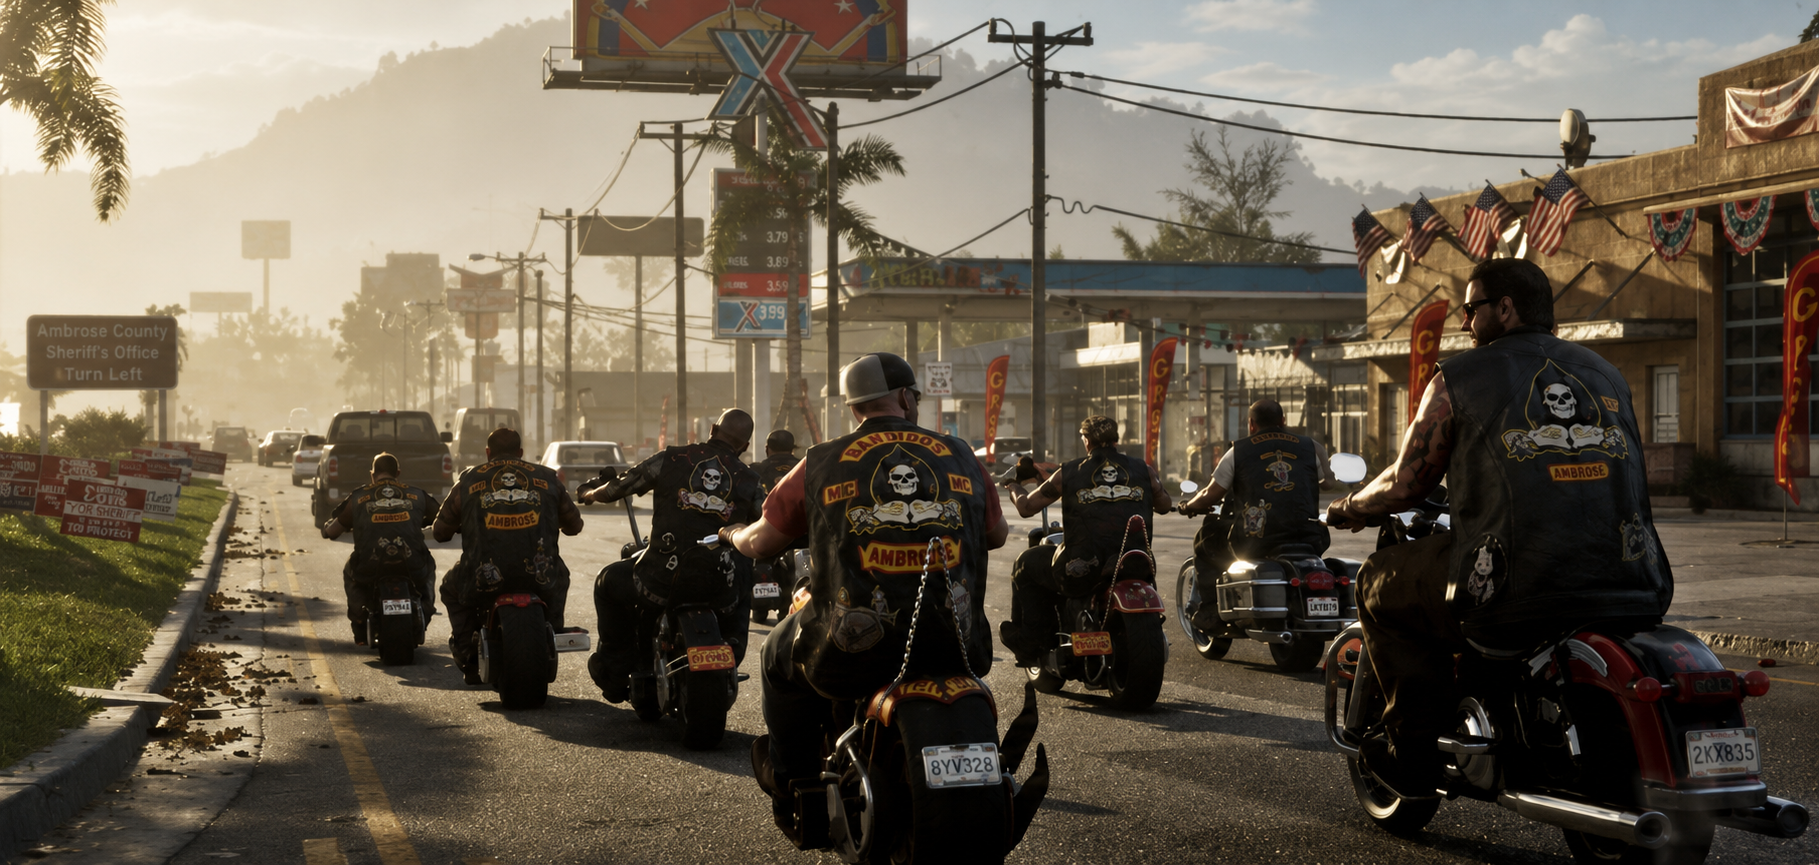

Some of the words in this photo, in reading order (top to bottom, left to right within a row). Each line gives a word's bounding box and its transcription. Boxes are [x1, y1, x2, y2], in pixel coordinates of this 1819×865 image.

[766, 231, 788, 243] 3.79
[766, 256, 789, 267] 3.89
[766, 280, 789, 292] 3.59
[37, 323, 108, 338] Ambrose
[113, 323, 168, 341] County
[46, 345, 109, 359] Sheriff's
[114, 345, 159, 359] Office
[64, 367, 103, 381] Turn
[109, 367, 143, 381] Left
[844, 432, 946, 459] BANDIDOS
[1554, 464, 1606, 479] AMBROSE
[951, 476, 971, 492] MC
[487, 513, 537, 528] AMBROSE
[1693, 742, 1755, 764] 2KX835
[931, 756, 994, 776] 8YV328
